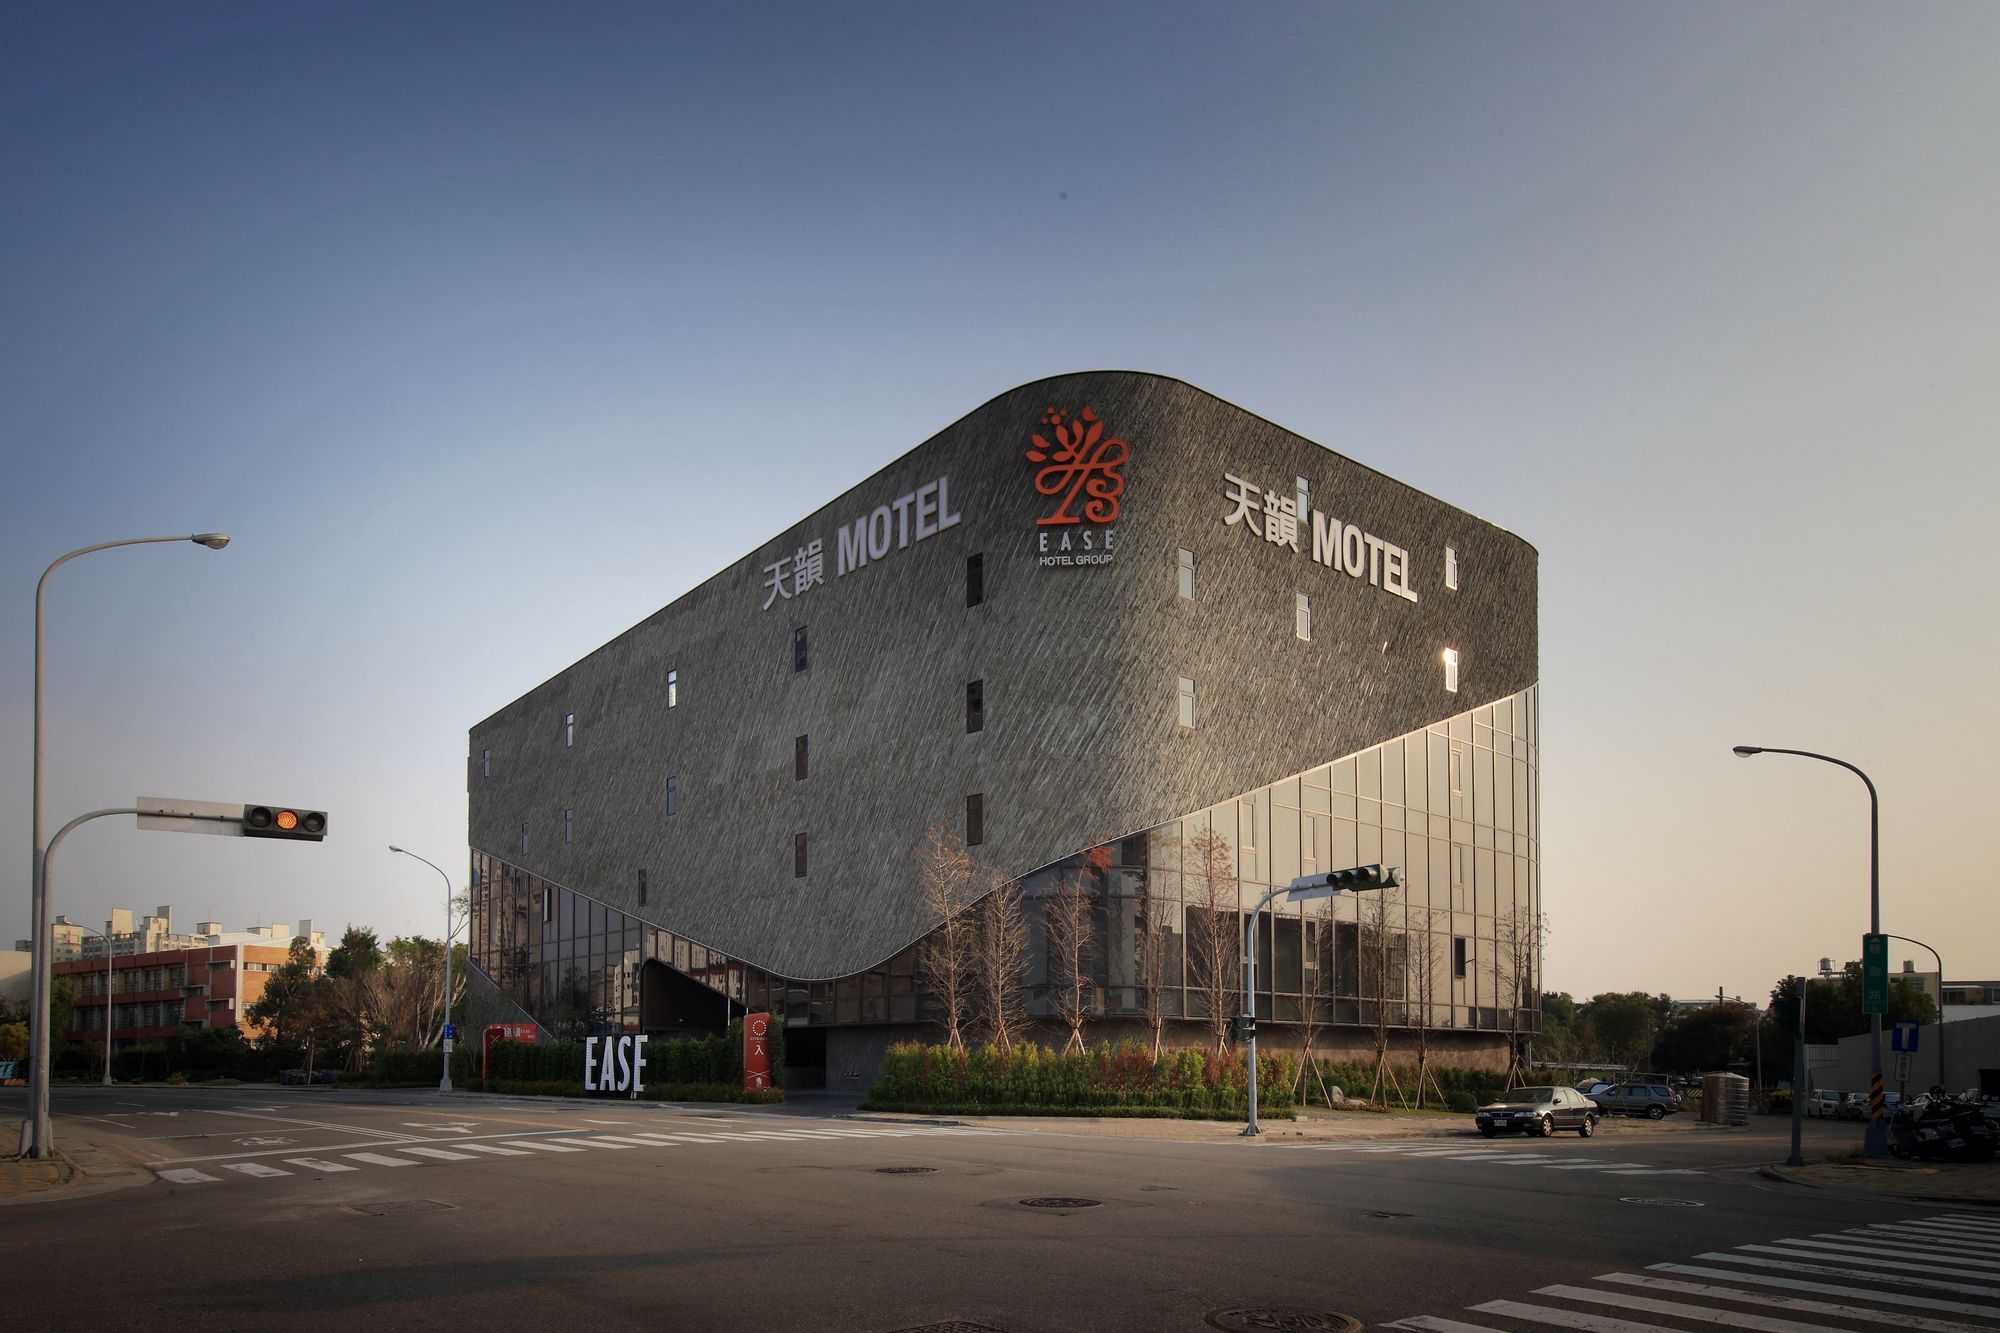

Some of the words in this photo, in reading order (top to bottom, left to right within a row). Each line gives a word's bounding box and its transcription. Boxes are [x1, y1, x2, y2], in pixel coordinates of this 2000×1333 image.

[762, 537, 825, 611] 天韻
[837, 475, 962, 577] MOTEL
[1039, 529, 1114, 552] EASE
[1223, 472, 1299, 553] 天韻
[1312, 508, 1418, 603] MOTEL
[1039, 555, 1074, 566] HOTEL
[1076, 554, 1113, 565] GROUP
[583, 1034, 648, 1092] EASE
[754, 1044, 764, 1056] 入
